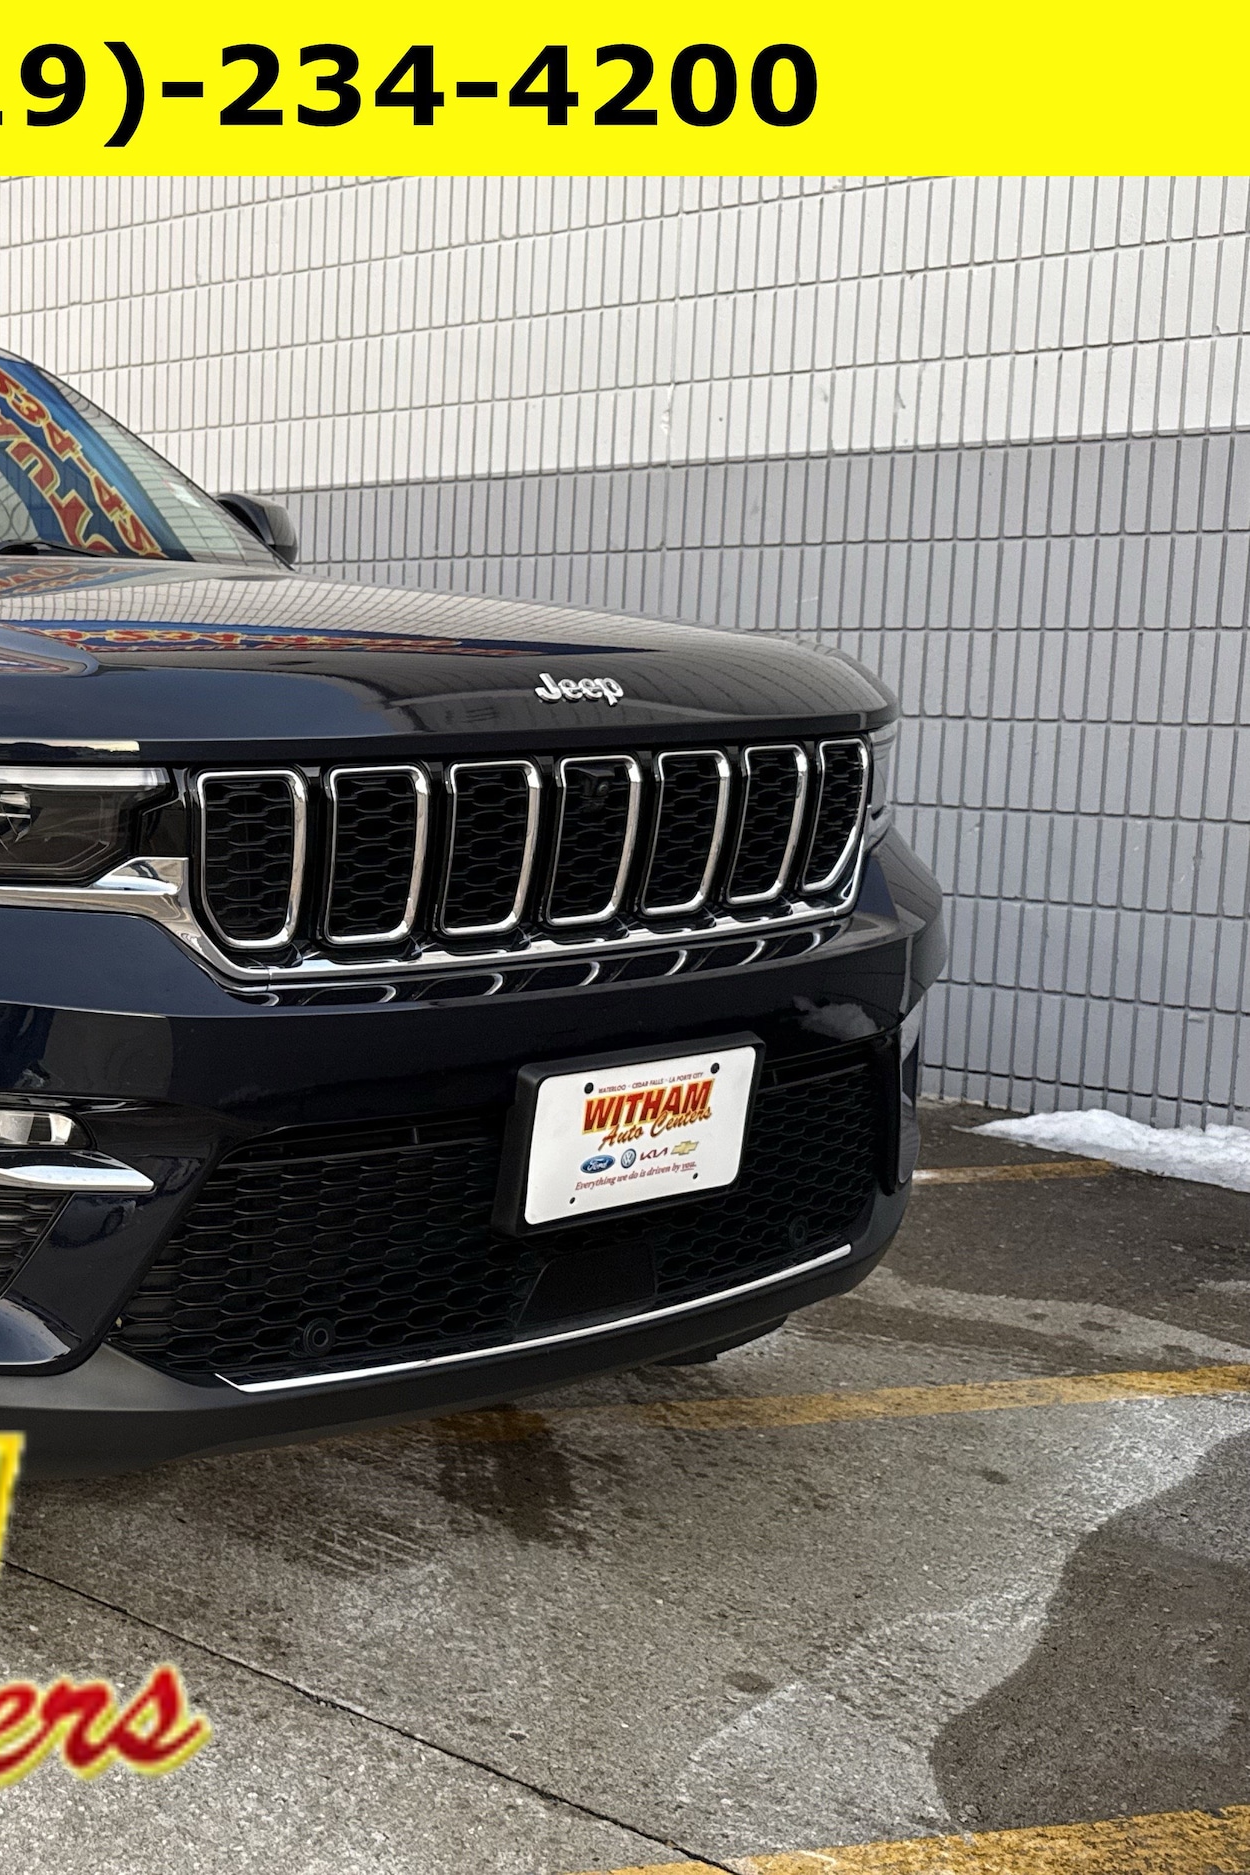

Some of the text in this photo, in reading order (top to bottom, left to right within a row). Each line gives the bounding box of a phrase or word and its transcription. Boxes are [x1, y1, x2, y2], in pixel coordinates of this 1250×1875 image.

[535, 673, 624, 705] Jeep
[599, 1084, 626, 1093] WATERLOO
[632, 1081, 648, 1089] CEDAR
[649, 1078, 664, 1086] FALLS
[676, 1074, 692, 1082] PORTE
[583, 1079, 714, 1133] WITHAM
[598, 1106, 713, 1151] Auto Centers
[575, 1174, 616, 1191] Everything
[617, 1174, 627, 1183] we
[628, 1169, 638, 1180] do
[639, 1169, 646, 1178] is
[647, 1165, 671, 1177] driven
[672, 1163, 681, 1173] by
